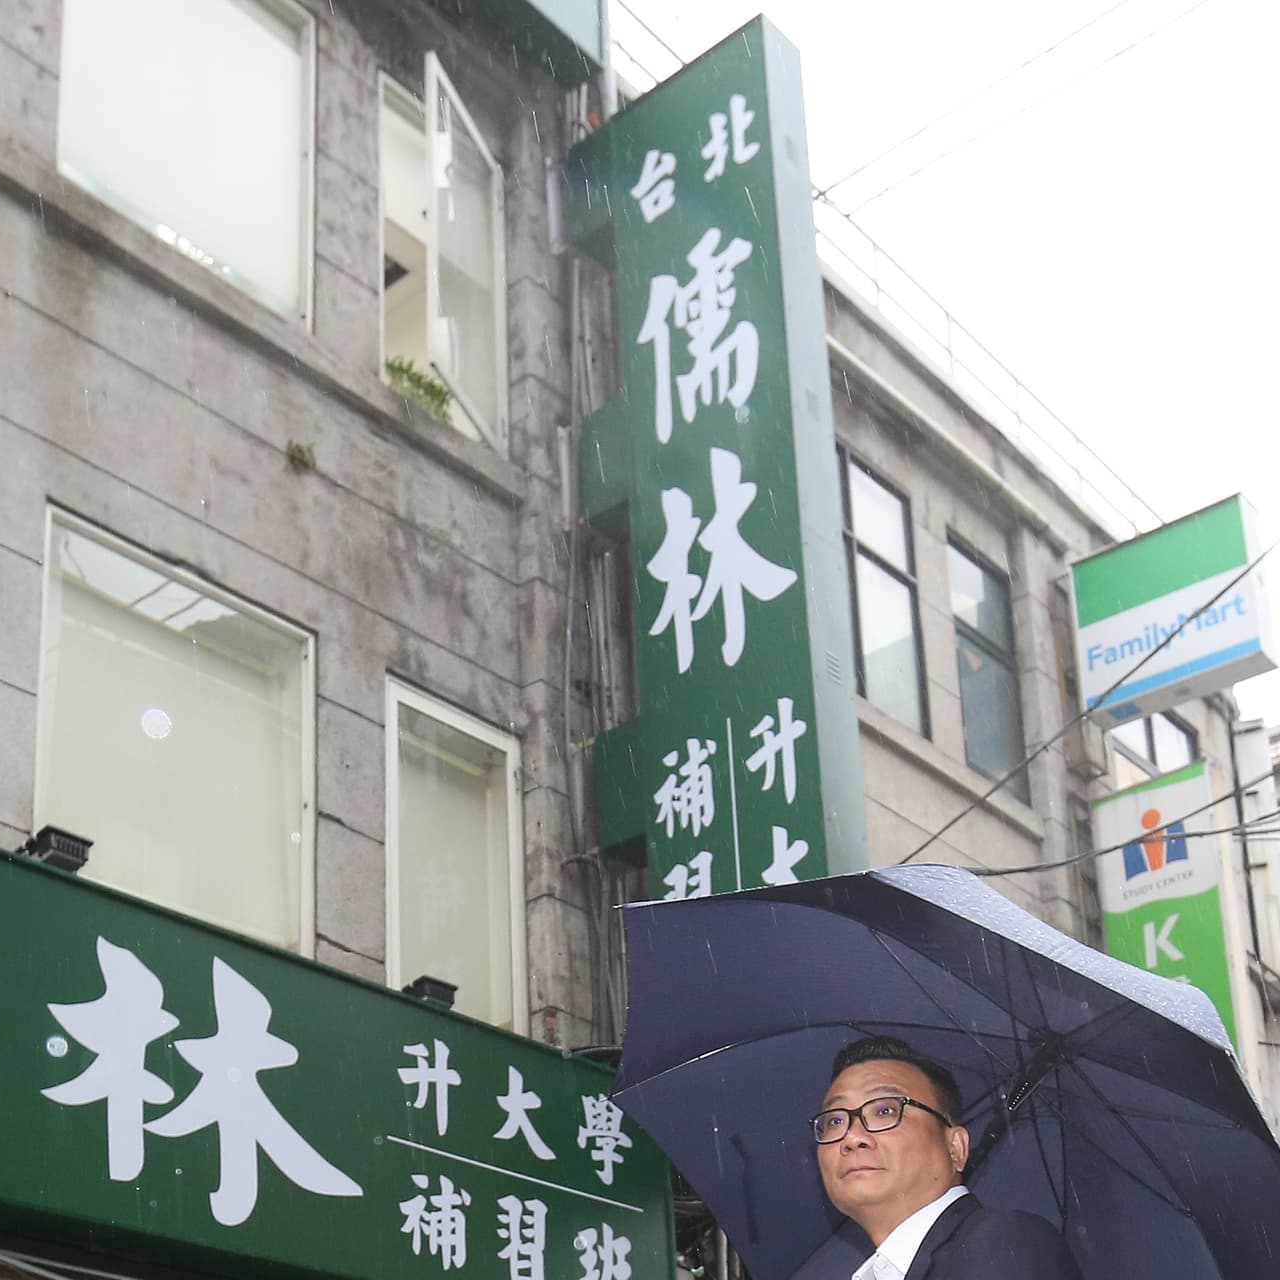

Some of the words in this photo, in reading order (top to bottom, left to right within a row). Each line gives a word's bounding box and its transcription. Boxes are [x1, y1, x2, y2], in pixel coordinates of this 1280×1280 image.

[630, 94, 761, 224] 台北
[635, 226, 798, 675] 儒林
[1087, 593, 1248, 672] FamilyMart
[1122, 878, 1155, 900] STUDY
[1156, 870, 1195, 890] CENTER
[1143, 913, 1190, 985] K
[396, 1038, 633, 1185] 升大學
